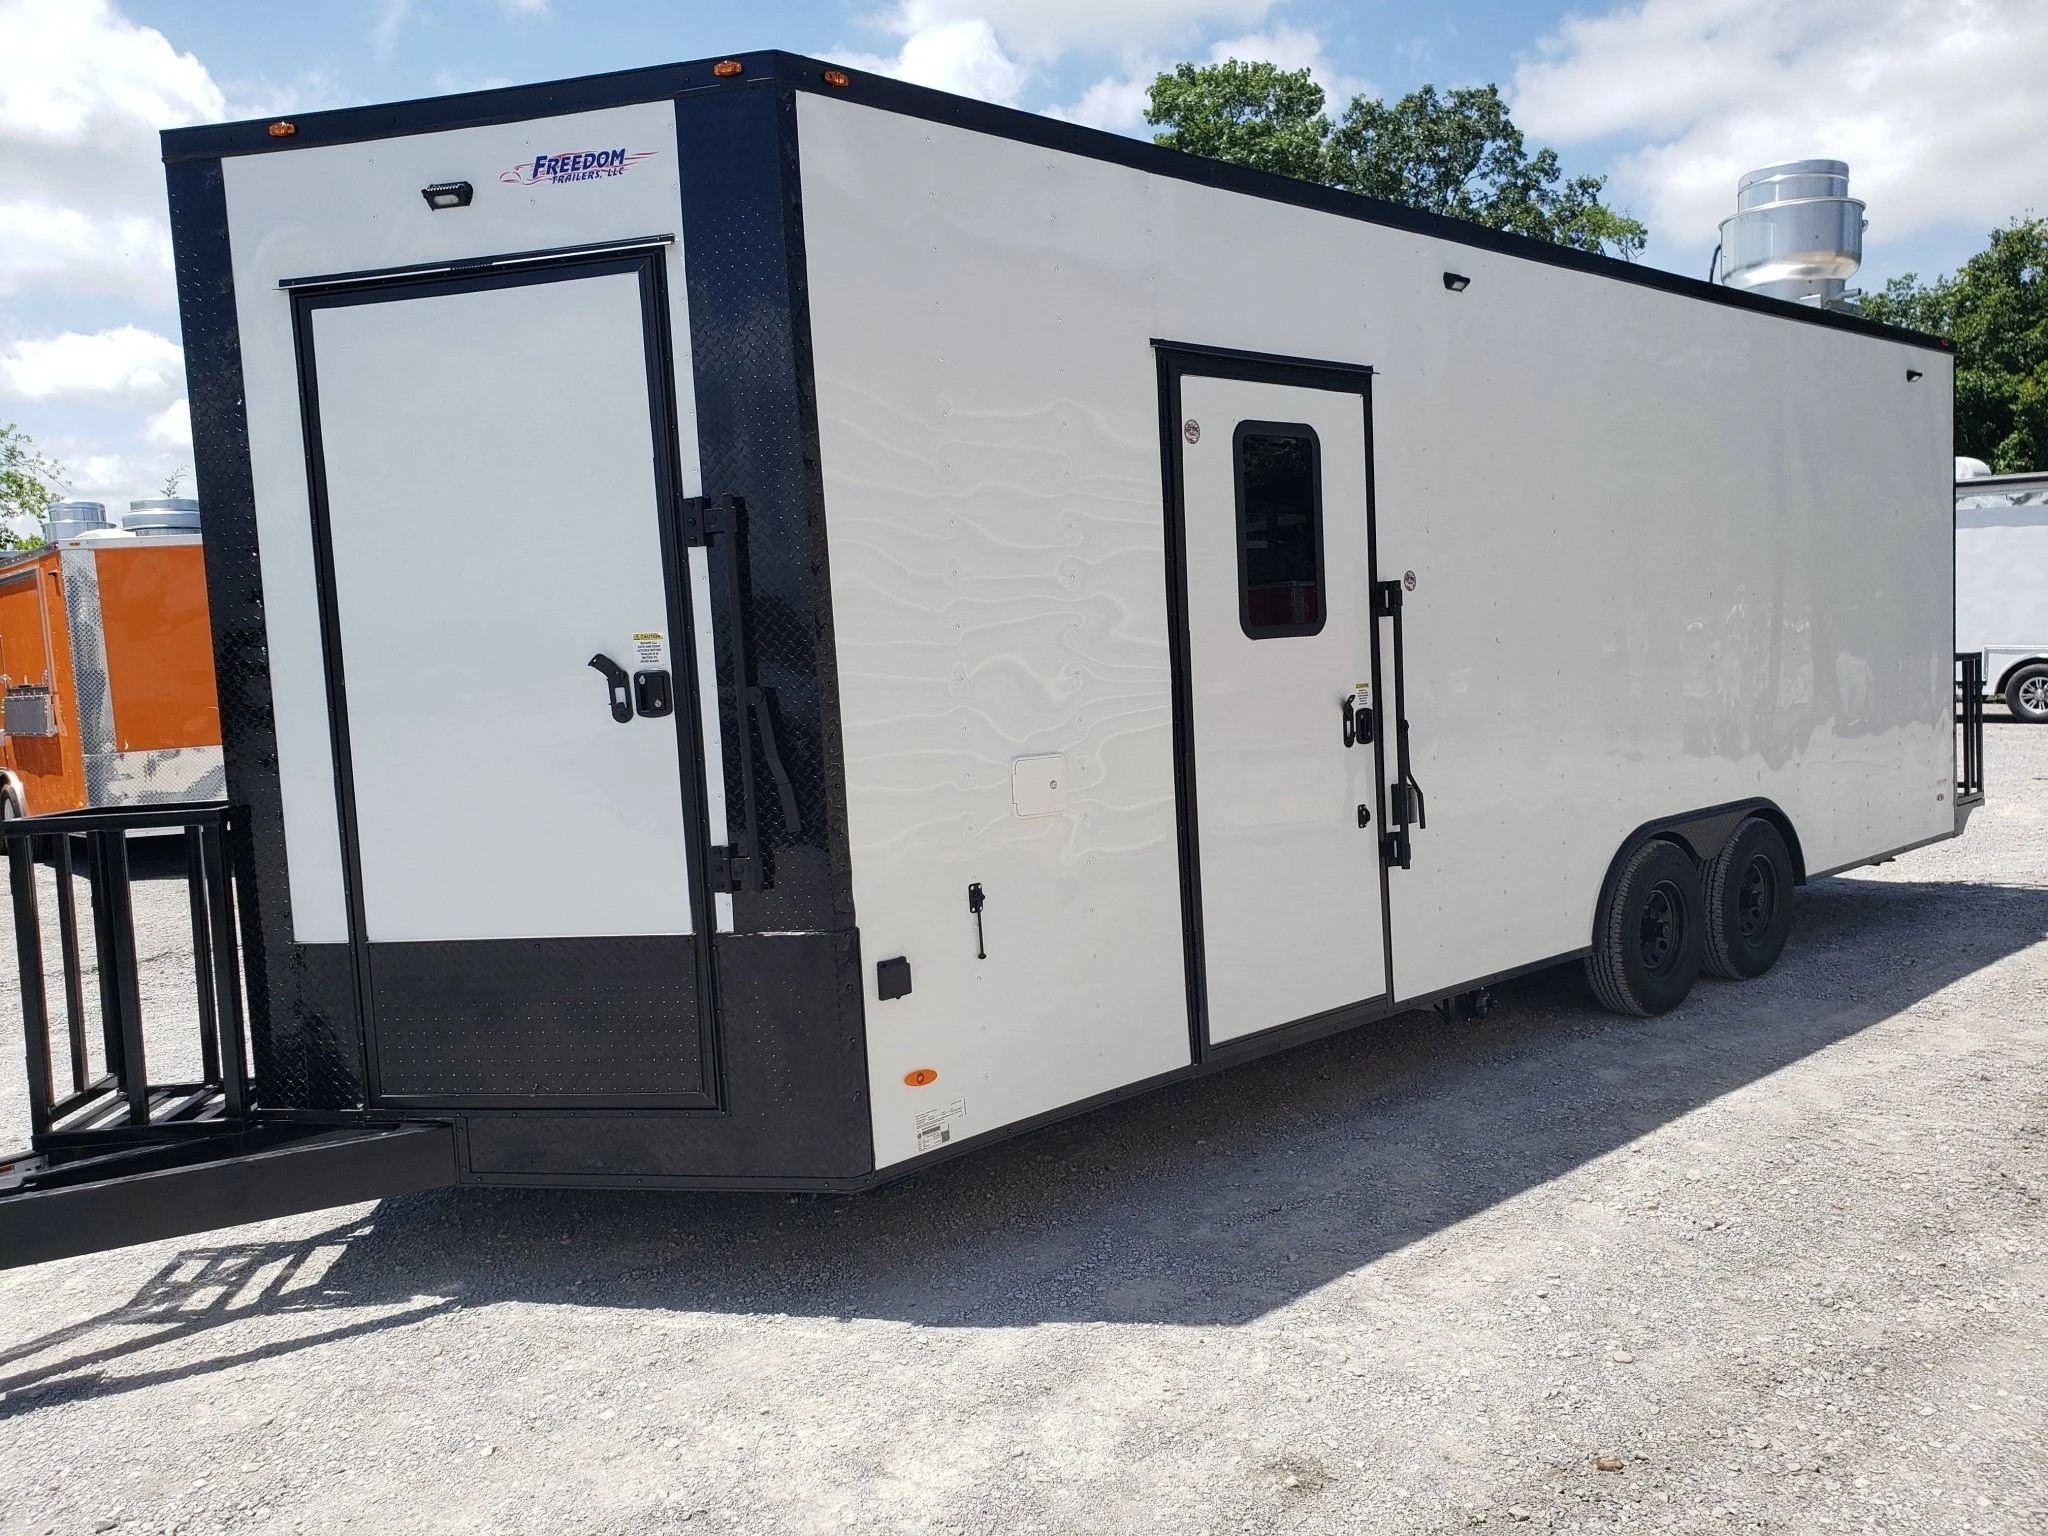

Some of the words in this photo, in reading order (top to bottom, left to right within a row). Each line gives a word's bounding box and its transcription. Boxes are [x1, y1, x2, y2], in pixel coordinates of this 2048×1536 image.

[532, 148, 626, 179] FREEDOM
[551, 171, 603, 184] TRAILERS,
[607, 167, 624, 177] LLC
